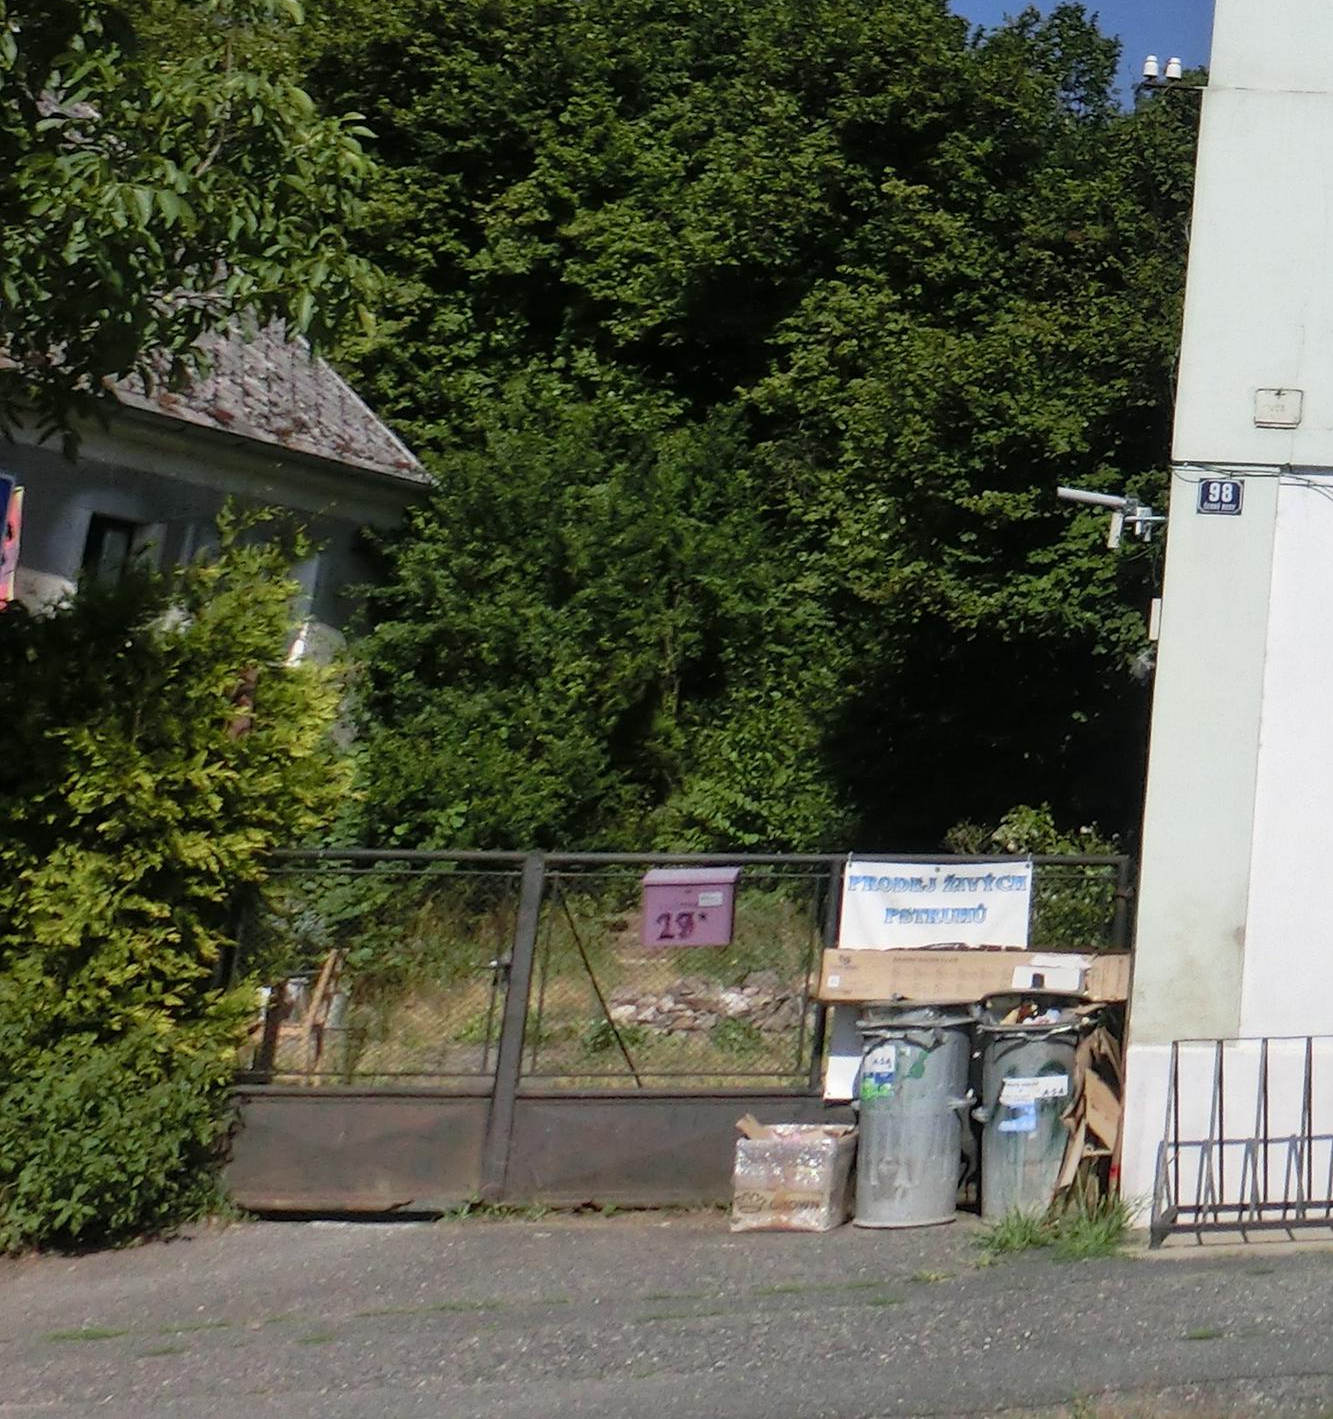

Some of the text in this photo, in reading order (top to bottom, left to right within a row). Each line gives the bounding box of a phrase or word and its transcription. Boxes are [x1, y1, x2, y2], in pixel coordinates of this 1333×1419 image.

[1208, 482, 1233, 503] 98
[848, 872, 1027, 893] PRODEJ ŽIVÝCH
[884, 903, 987, 925] PSTRUHŮ
